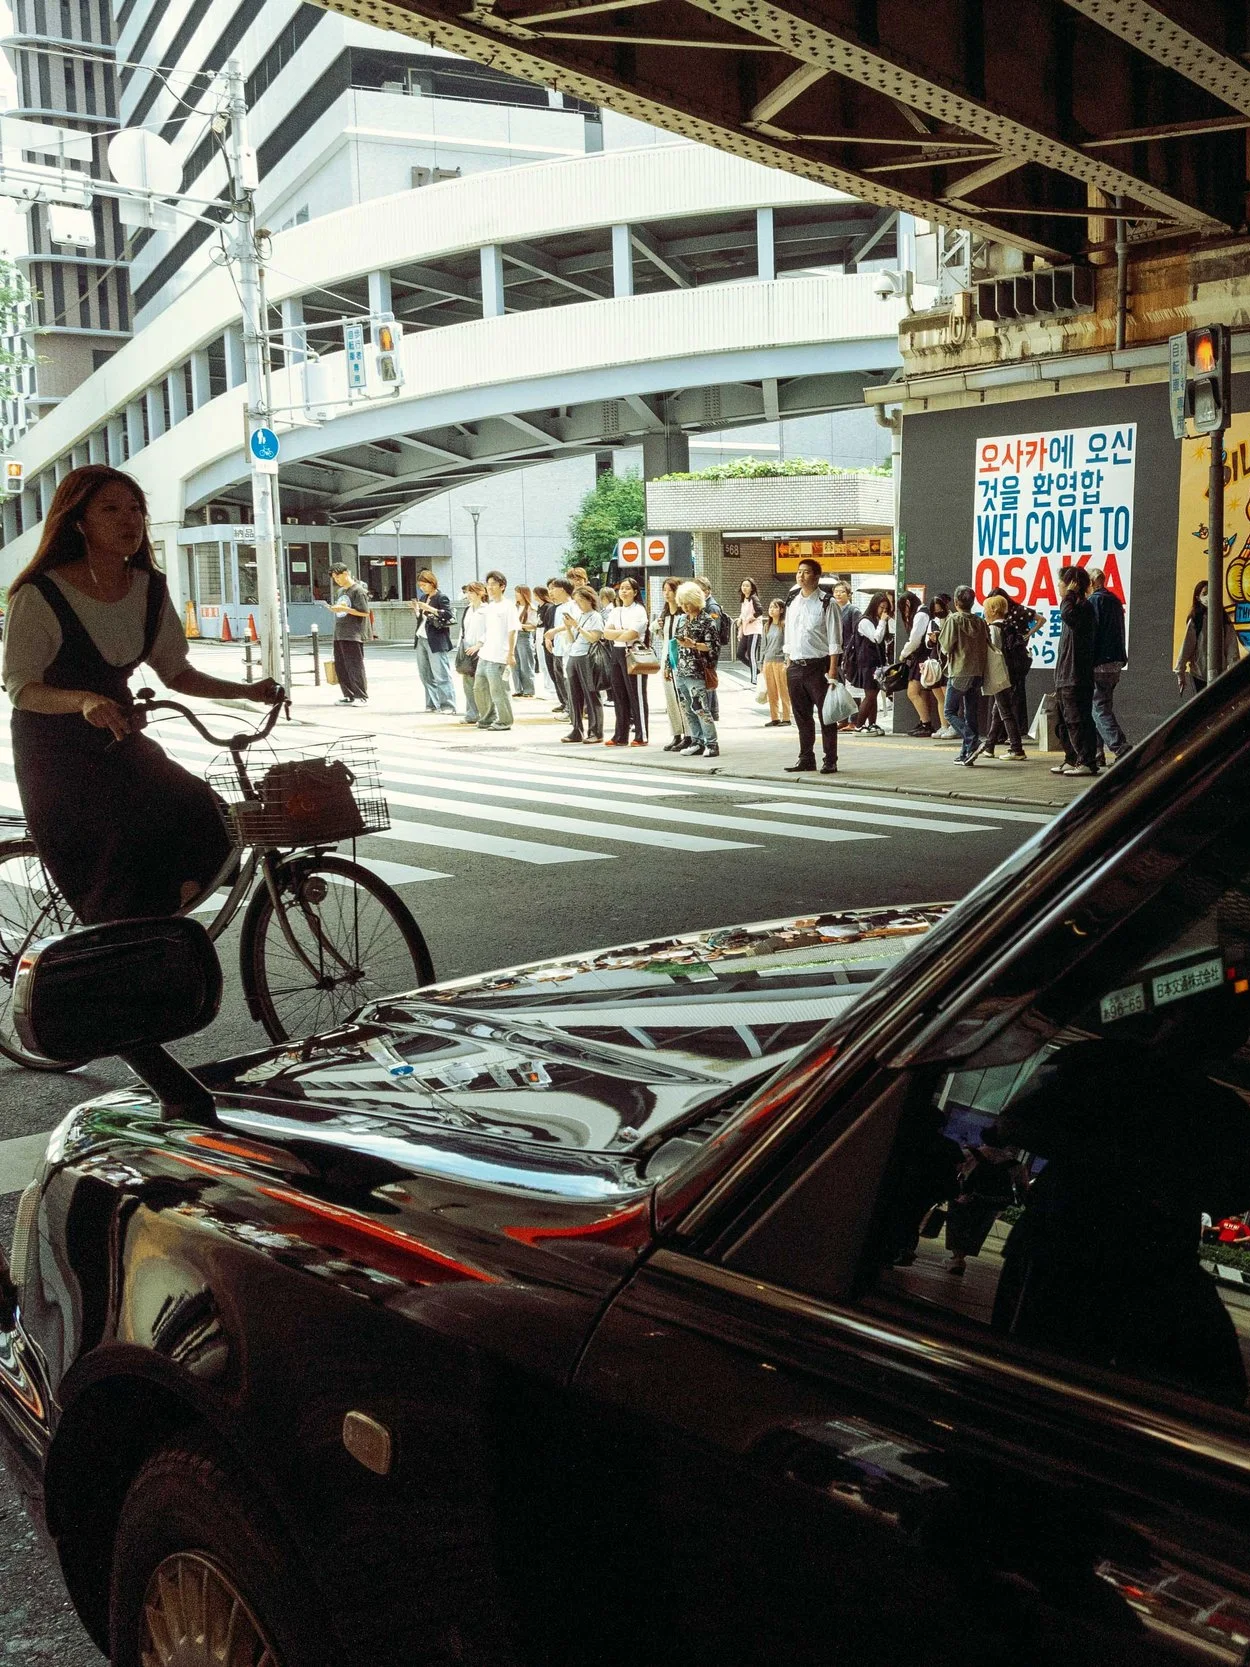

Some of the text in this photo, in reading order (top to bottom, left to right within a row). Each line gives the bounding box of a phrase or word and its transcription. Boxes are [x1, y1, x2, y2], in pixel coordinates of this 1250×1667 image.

[979, 428, 1133, 473] 오사카에 오신
[978, 469, 1104, 512] 것을 환영합
[977, 505, 1130, 556] WELCOME TO
[975, 553, 1127, 607] OSAA
